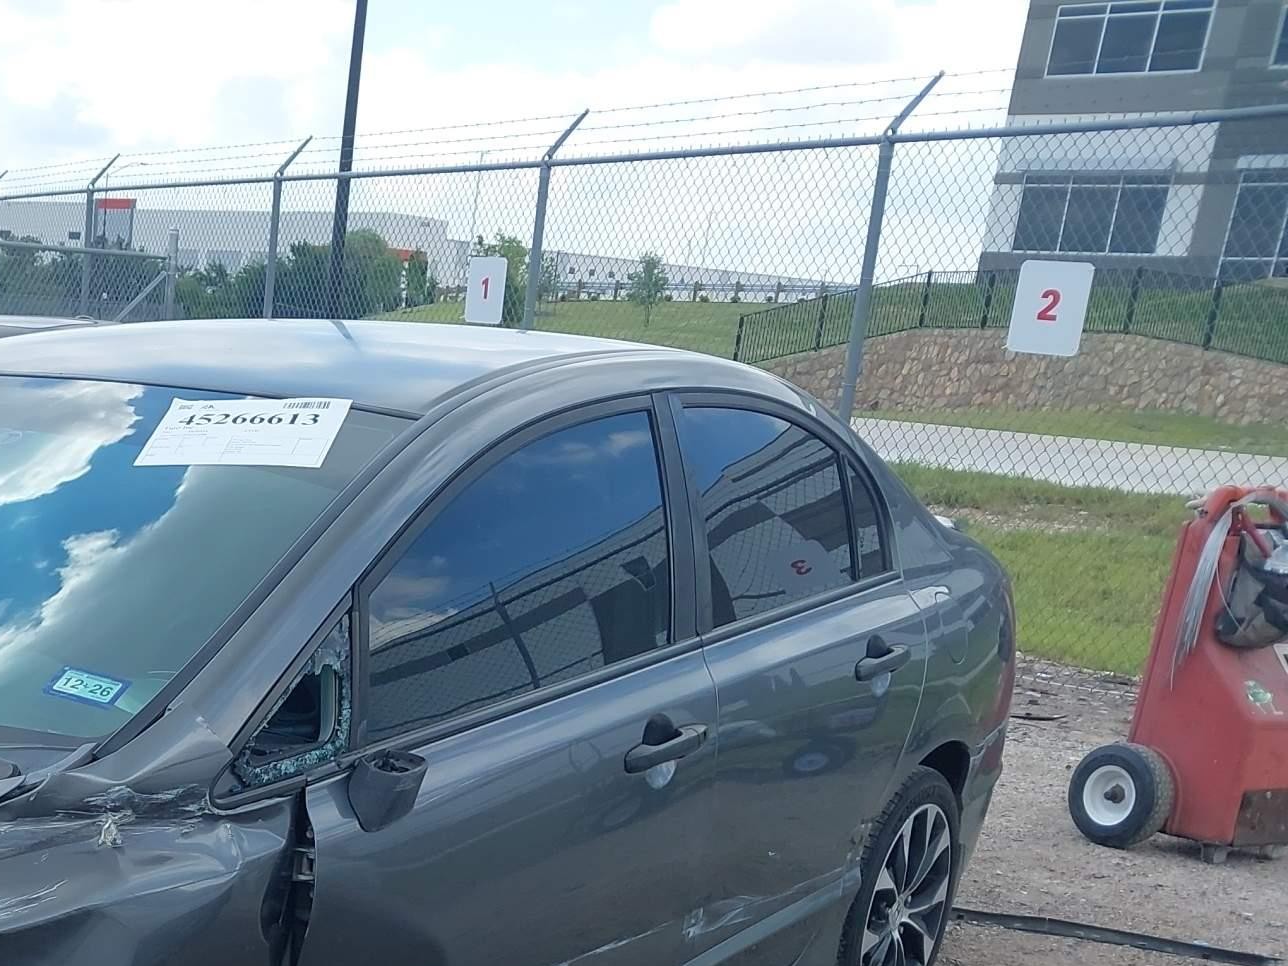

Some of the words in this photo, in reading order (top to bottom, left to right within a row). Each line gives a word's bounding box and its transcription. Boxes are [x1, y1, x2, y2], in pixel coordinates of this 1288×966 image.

[481, 277, 489, 299] 1
[1036, 289, 1061, 321] 2
[178, 412, 320, 425] 45266613
